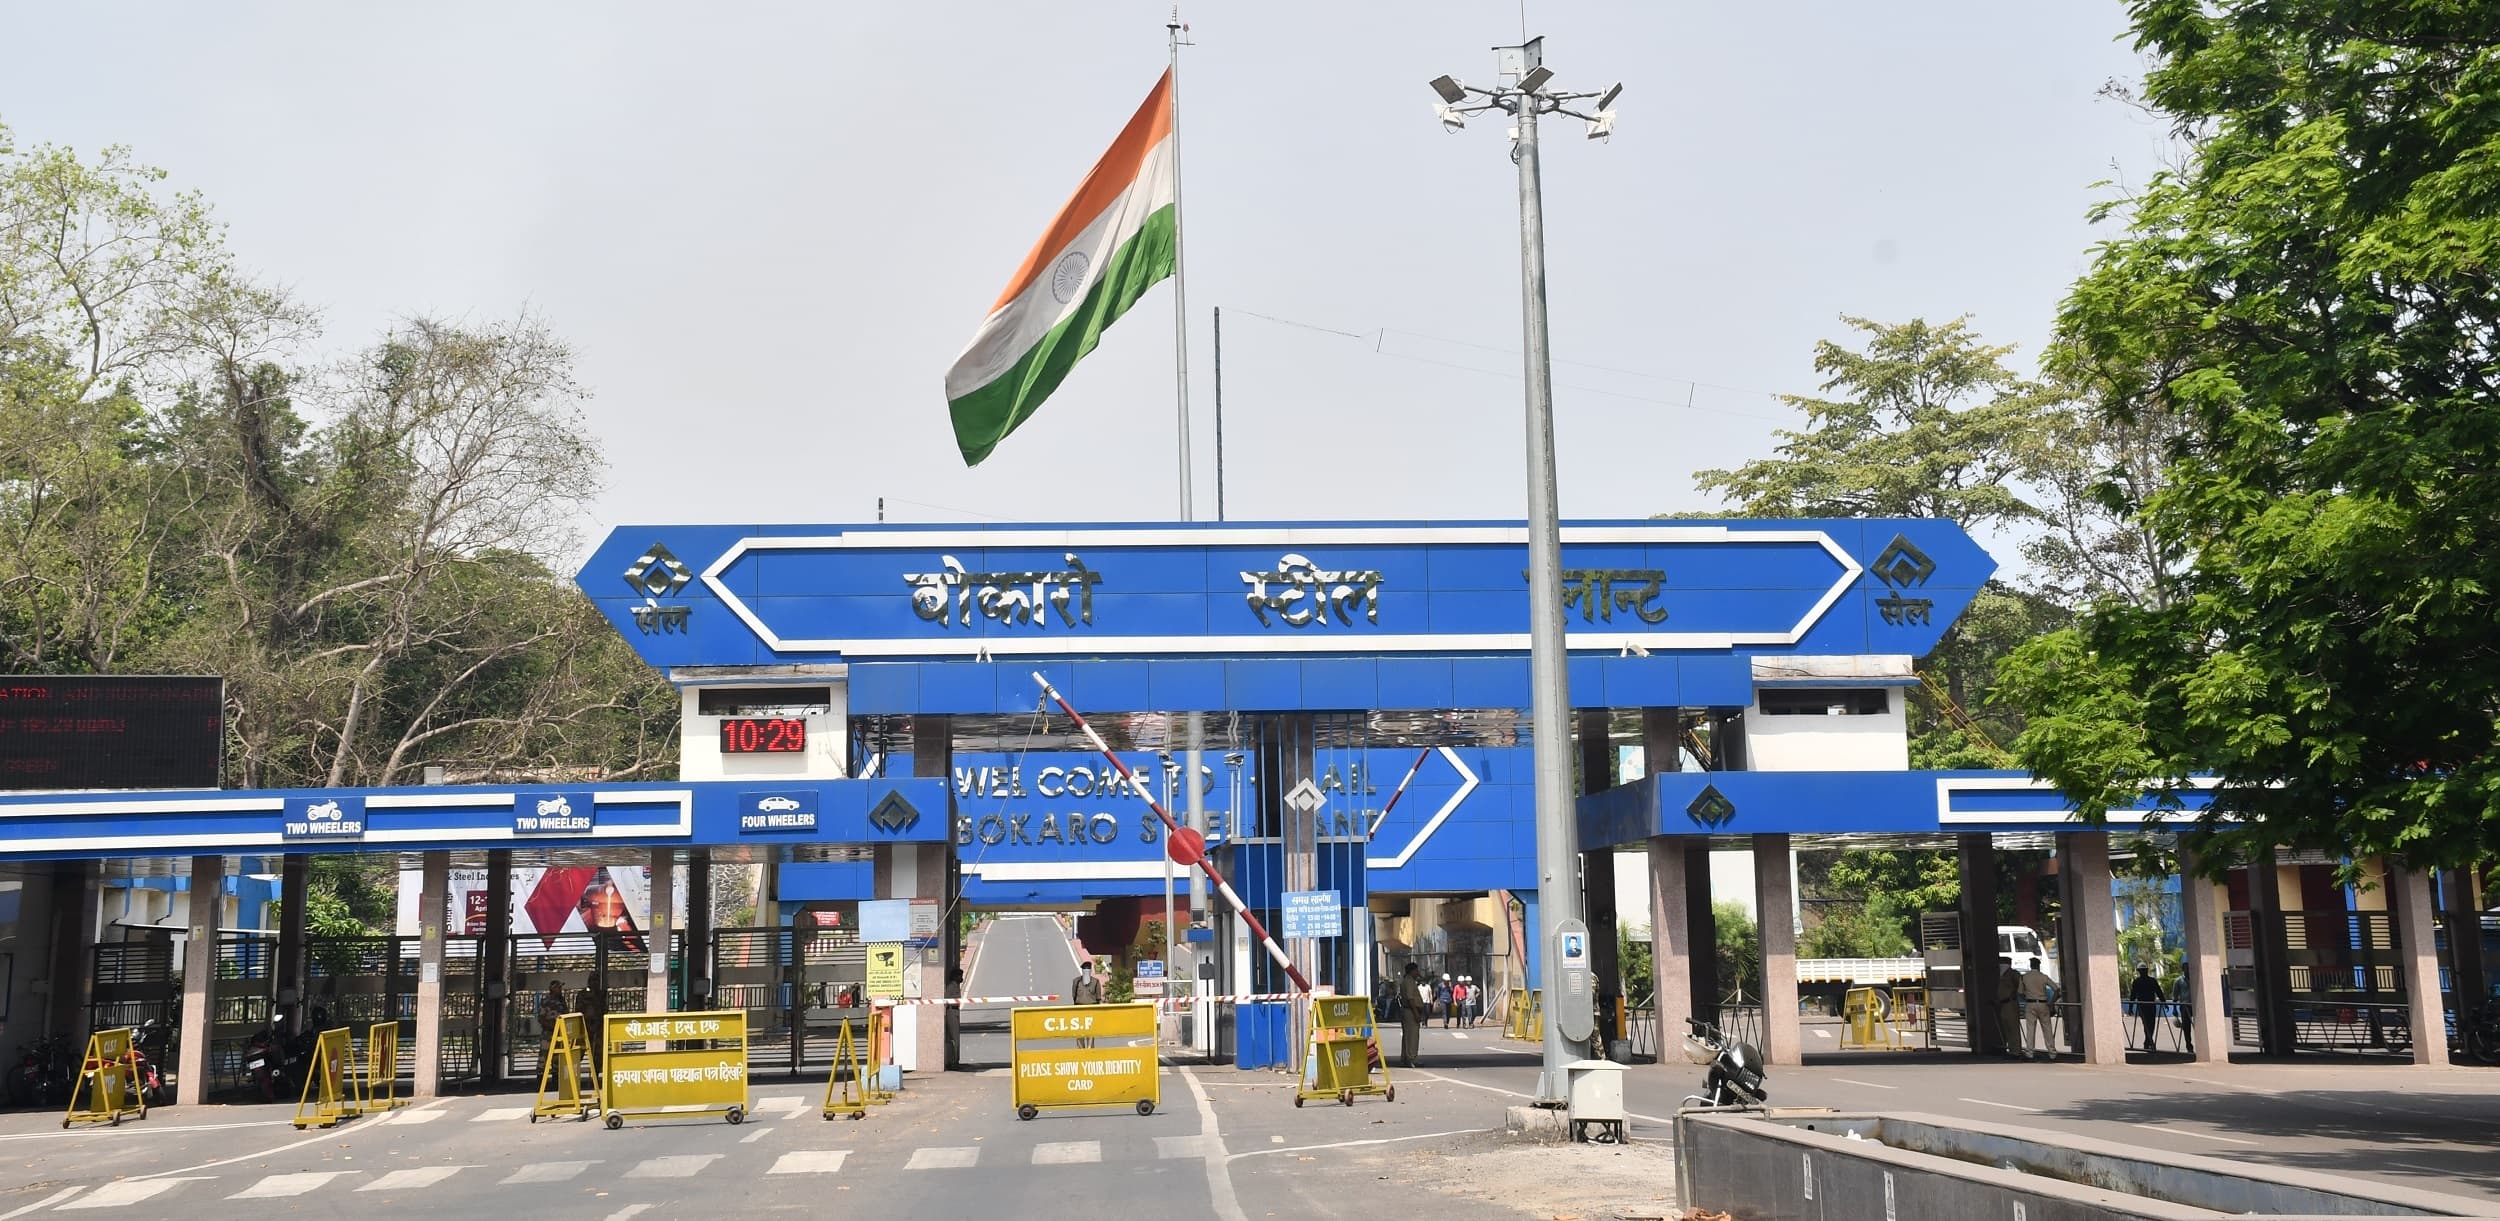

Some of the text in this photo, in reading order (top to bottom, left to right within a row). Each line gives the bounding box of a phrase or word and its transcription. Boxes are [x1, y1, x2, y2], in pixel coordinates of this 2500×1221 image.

[903, 553, 1103, 627] बोकारो
[1240, 554, 1384, 627] स्टील
[630, 598, 692, 635] सेल
[1875, 591, 1933, 626] सेल
[724, 720, 804, 751] 10:29
[286, 821, 361, 835] TWO WHEELERS
[516, 817, 590, 830] TWO WHEELERS
[742, 813, 815, 828] FOUR WHEELERS
[956, 812, 1117, 845] BOKARO
[454, 872, 475, 881] Steel
[1334, 1048, 1351, 1067] STOP
[612, 1070, 641, 1088] कृपया
[641, 1069, 668, 1084] अपना
[704, 1066, 719, 1080] पत्र
[1021, 1059, 1142, 1078] PLEASE SHOW YOUR IDENTITY
[1067, 1079, 1094, 1091] CARD
